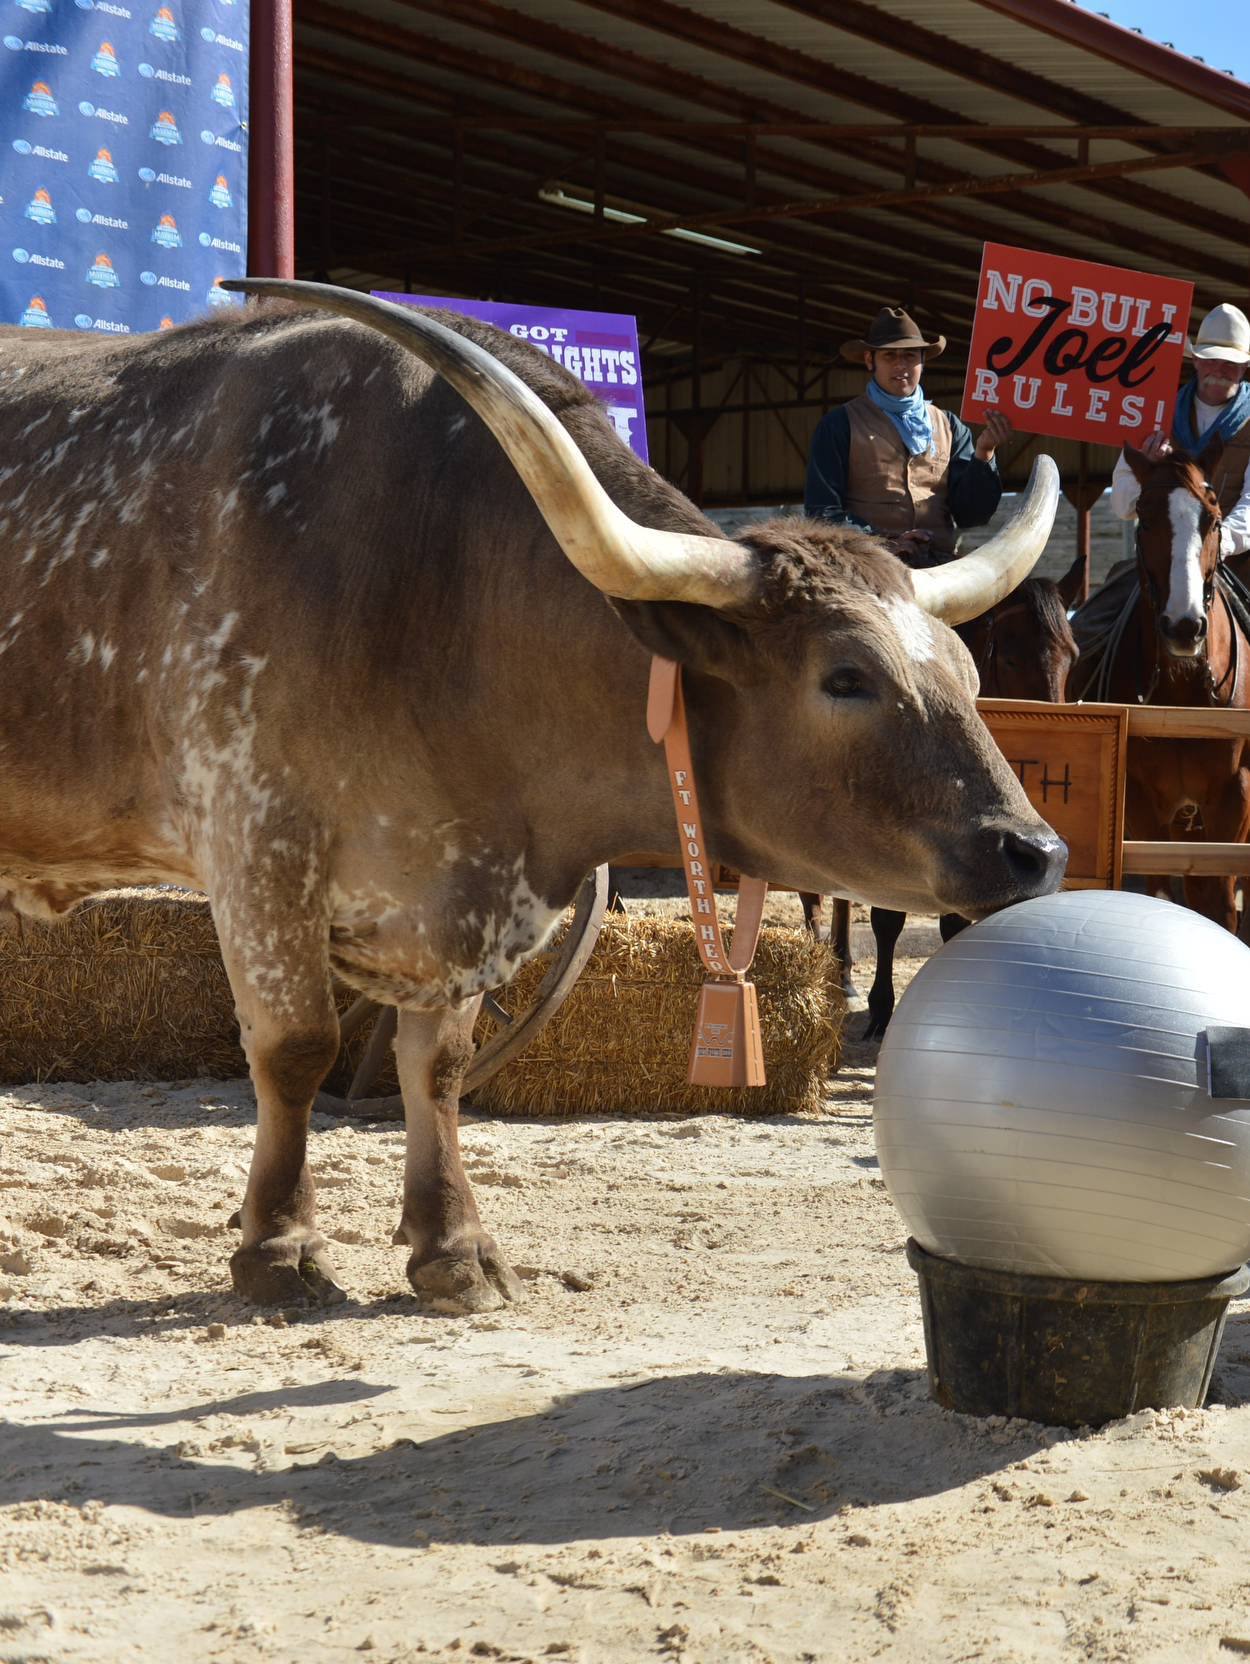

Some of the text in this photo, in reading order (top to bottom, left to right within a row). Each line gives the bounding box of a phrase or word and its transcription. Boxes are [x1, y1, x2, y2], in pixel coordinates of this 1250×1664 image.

[94, 1, 131, 18] Allstate
[24, 40, 68, 55] Allstate
[215, 34, 243, 51] Allstate
[155, 69, 191, 85] Allstate
[95, 107, 128, 124] Allstate
[215, 136, 242, 152] Allstate
[32, 145, 69, 162] Allstate
[156, 173, 192, 188] Allstate
[92, 214, 128, 229] Allstate
[211, 238, 241, 252] Allstate
[29, 254, 65, 269] Allstate
[157, 276, 191, 291] Allstate
[983, 270, 1183, 344] NO BULL
[94, 319, 130, 333] Allstate
[509, 324, 568, 342] GOT
[986, 296, 1174, 388] Joel
[971, 368, 1165, 431] RULES!
[675, 771, 691, 805] FT
[682, 823, 711, 913] WORTH
